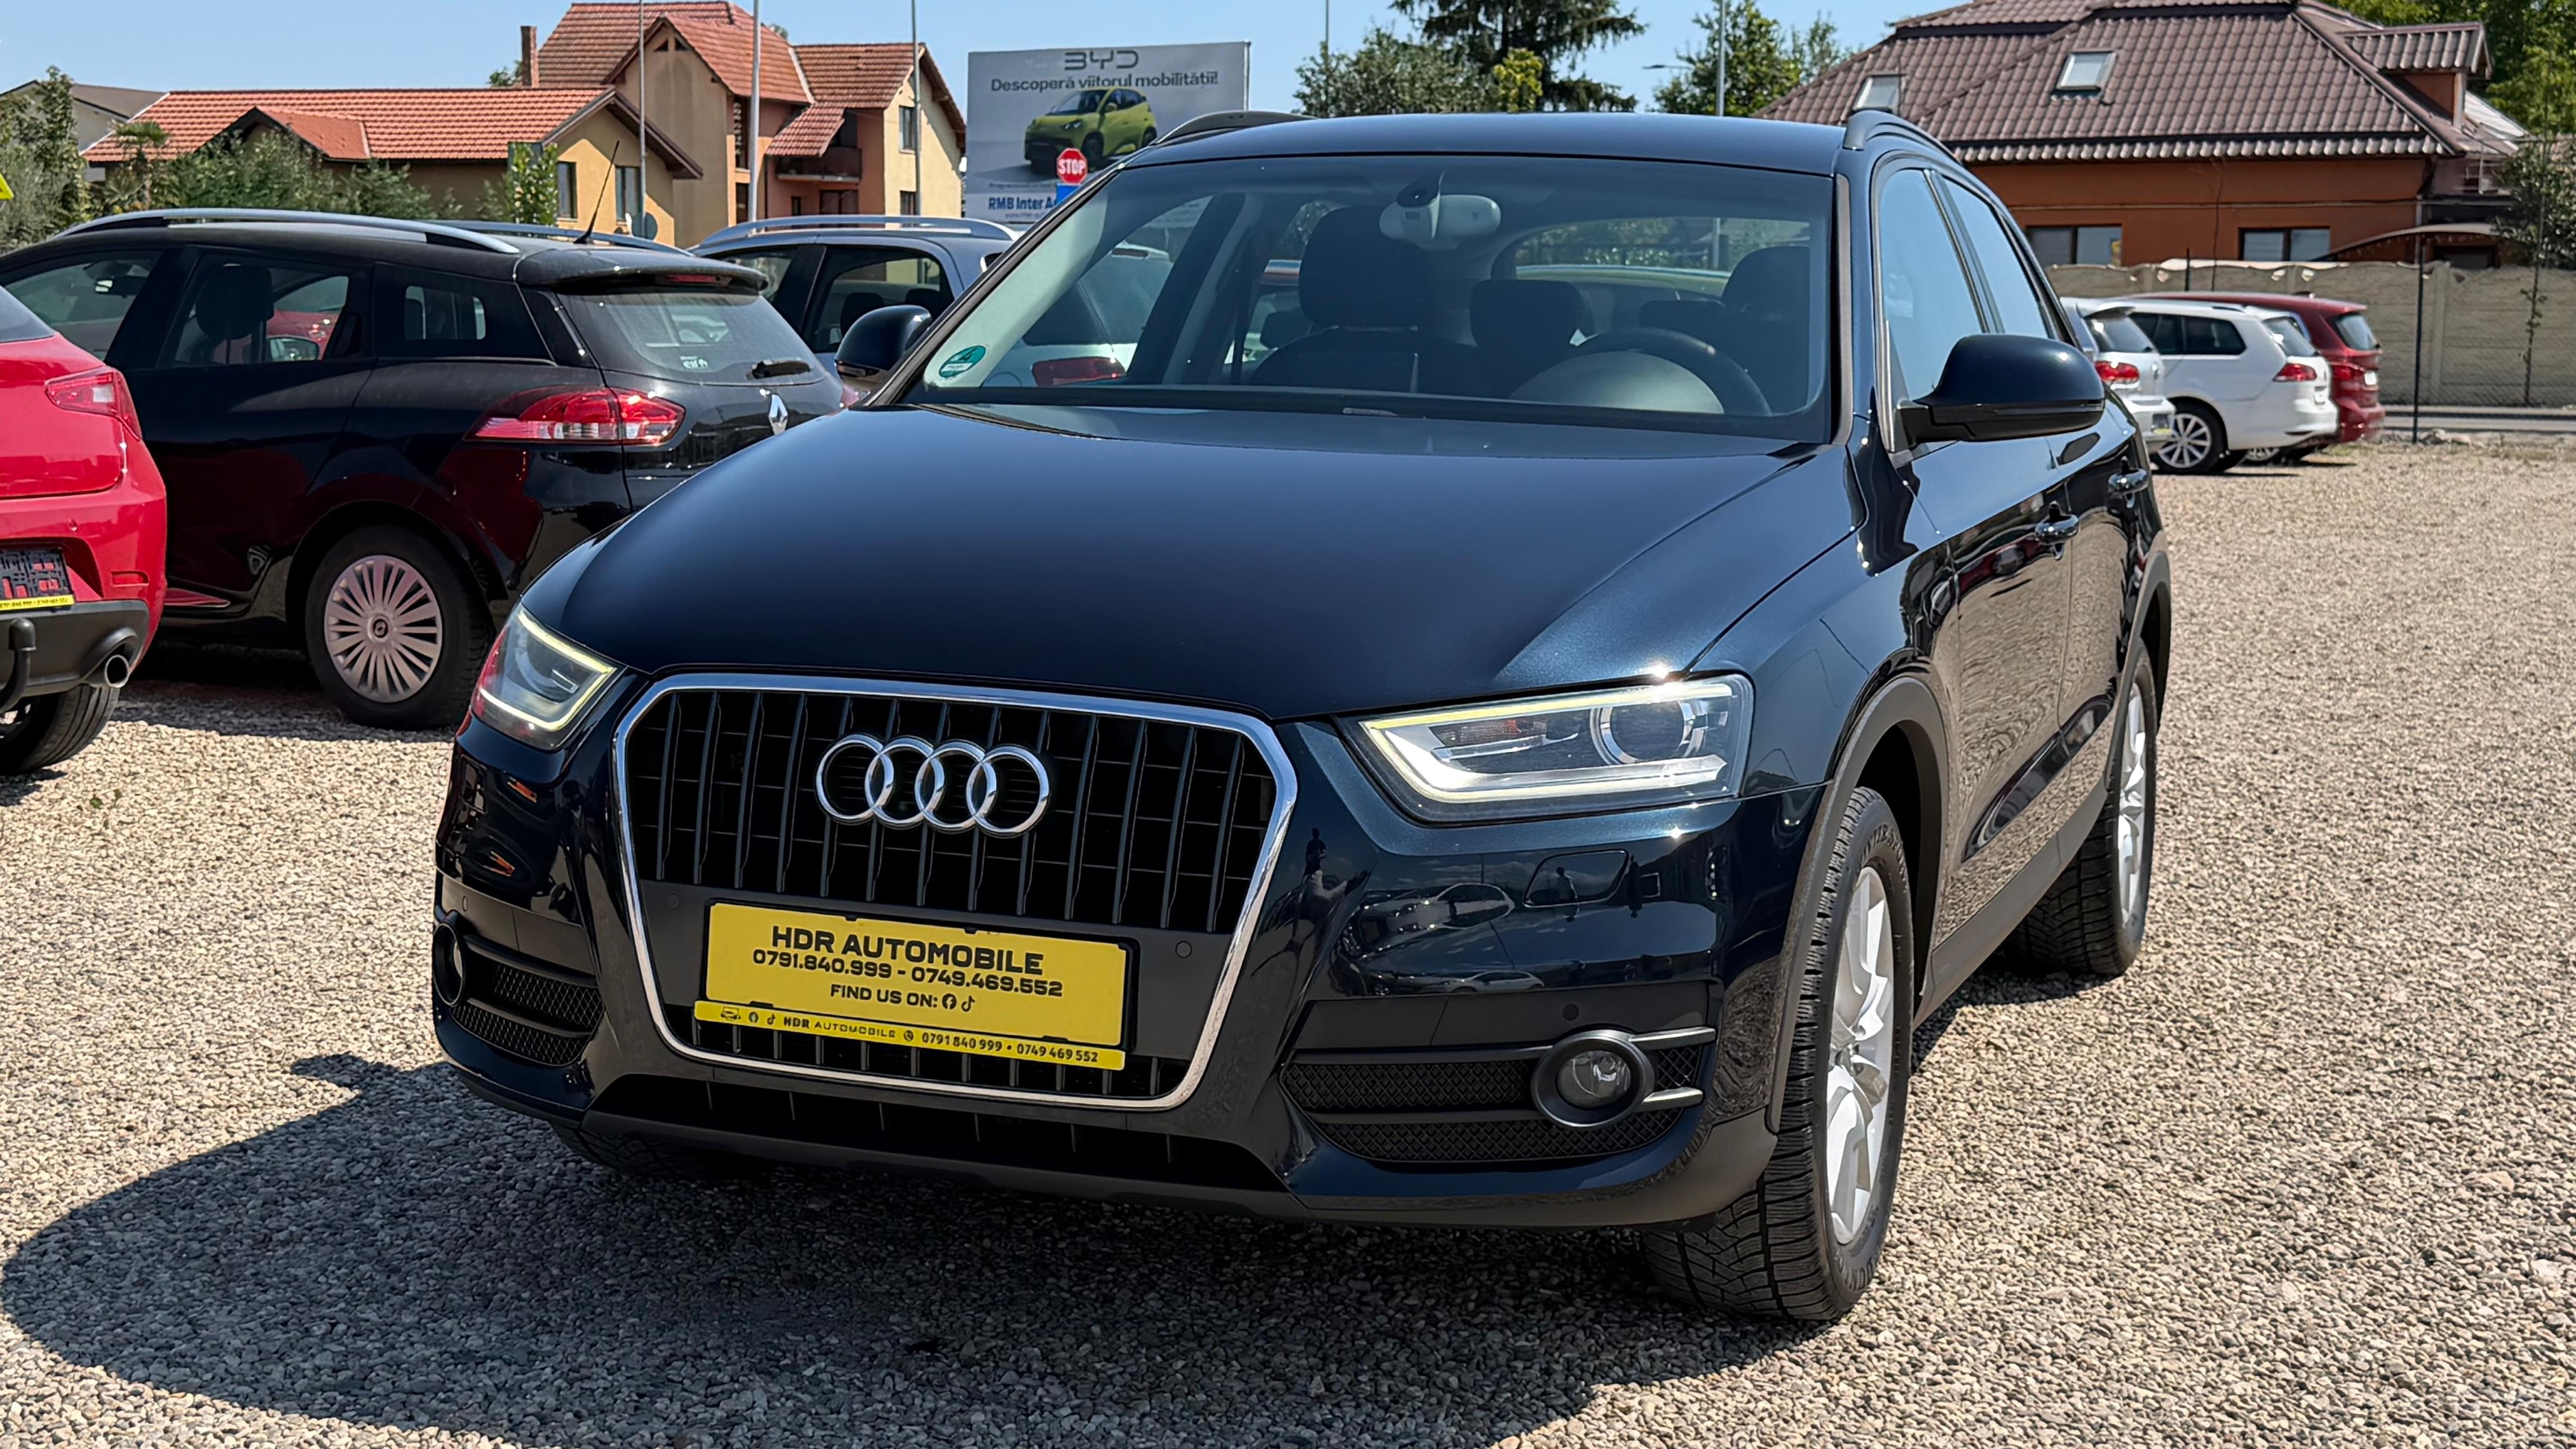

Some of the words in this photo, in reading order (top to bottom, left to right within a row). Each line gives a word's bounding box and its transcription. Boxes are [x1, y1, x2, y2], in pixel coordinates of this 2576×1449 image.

[1064, 50, 1139, 70] BYD
[991, 76, 1075, 93] Descoperă
[1078, 73, 1132, 89] viitorul
[1058, 159, 1087, 176] STOP
[989, 197, 1014, 210] RMB
[1016, 197, 1043, 210] Inter
[772, 925, 835, 953] HDR
[841, 934, 1044, 975] AUTOMOBILE
[753, 949, 893, 979] 0791.840.999
[911, 967, 1063, 997] 0749.469.552
[830, 984, 872, 1001] FIND
[876, 989, 902, 1005] US
[906, 992, 938, 1008] ON:
[783, 1016, 810, 1029] HDR
[814, 1021, 896, 1038] AUTOMOBILE
[922, 1032, 950, 1045] 0791
[953, 1036, 977, 1049] 840
[979, 1038, 1003, 1052] 999
[1017, 1043, 1046, 1056] 0749
[1049, 1046, 1073, 1060] 469
[1075, 1050, 1099, 1063] 552
